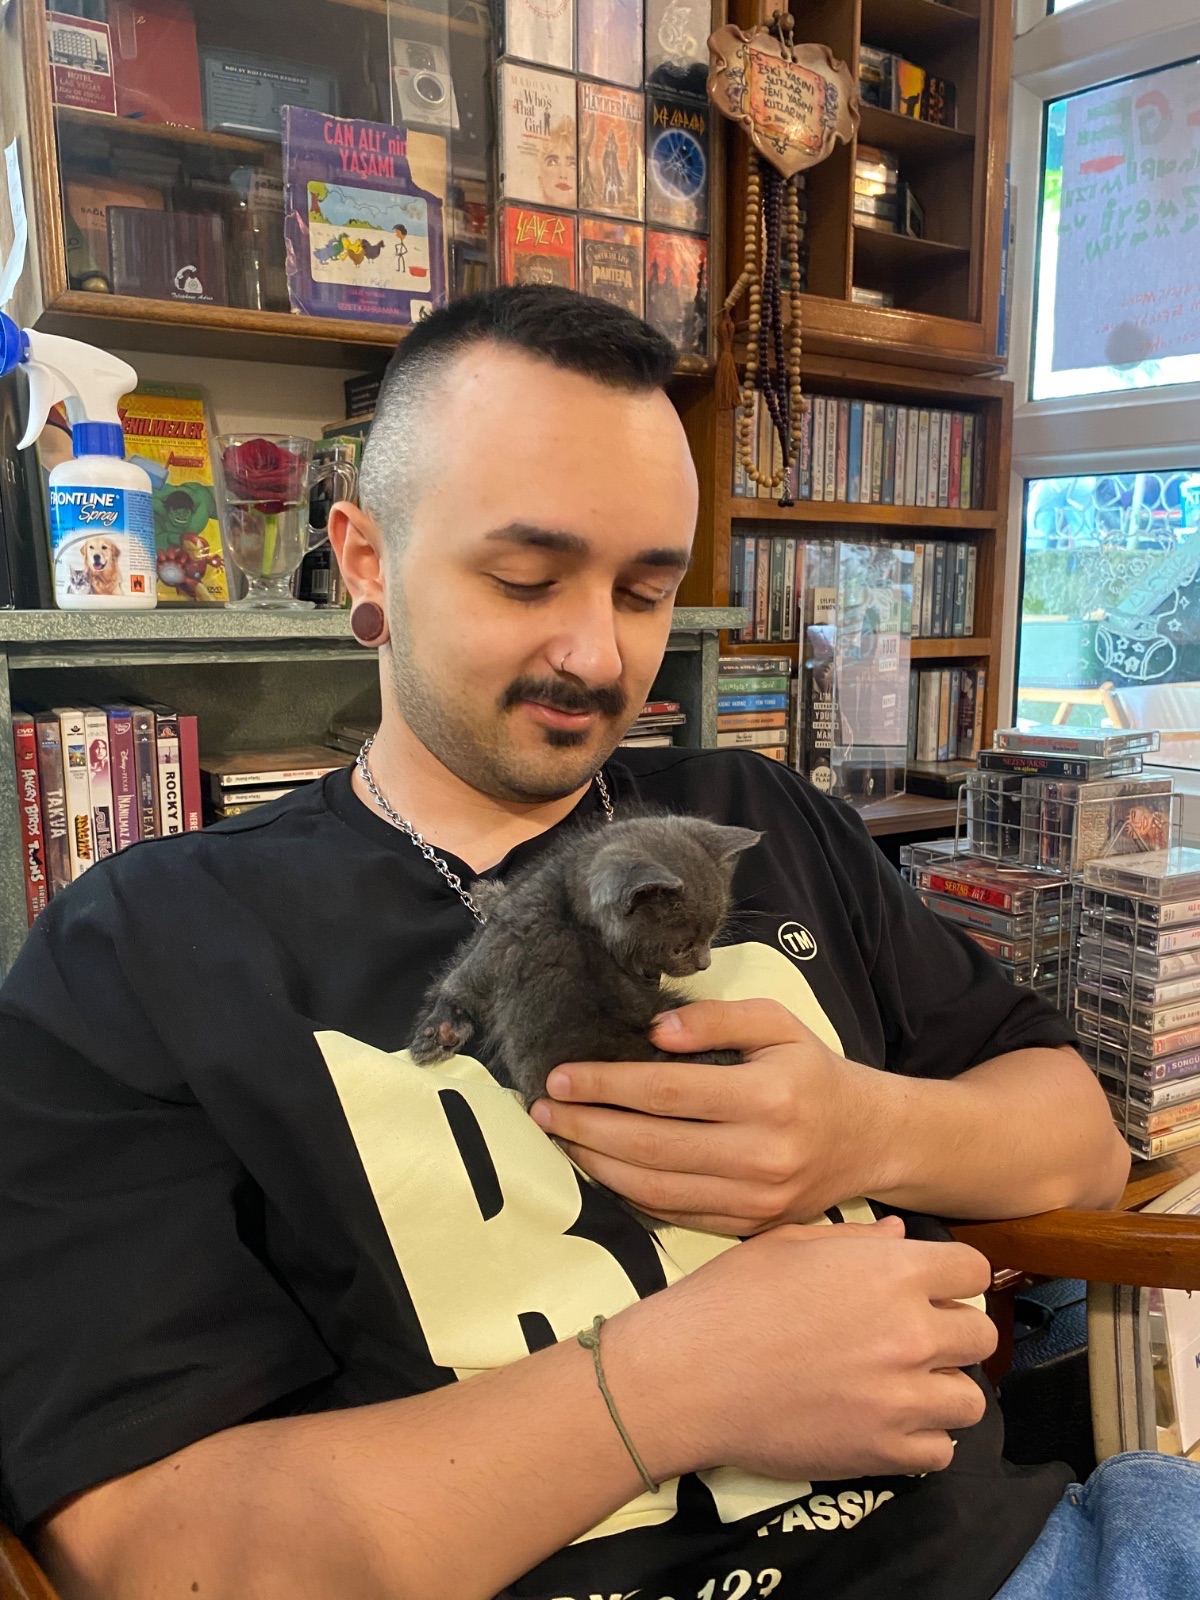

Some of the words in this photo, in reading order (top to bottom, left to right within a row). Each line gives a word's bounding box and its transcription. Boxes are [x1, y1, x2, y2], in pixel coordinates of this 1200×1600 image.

[513, 98, 535, 117] That
[524, 89, 552, 110] Who's
[324, 121, 354, 148] CAN
[524, 116, 543, 135] Girl
[516, 211, 566, 245] SLAYER
[592, 265, 633, 289] PANTERA
[51, 491, 115, 507] FRONTLINE
[79, 504, 118, 526] Spray
[121, 749, 129, 773] Disney
[21, 769, 37, 803] ANGRY
[166, 771, 178, 820] ROCKY
[24, 804, 40, 837] BIRDS
[47, 788, 67, 840] TAKVA
[28, 841, 45, 882] TOONS
[781, 928, 815, 954] TM
